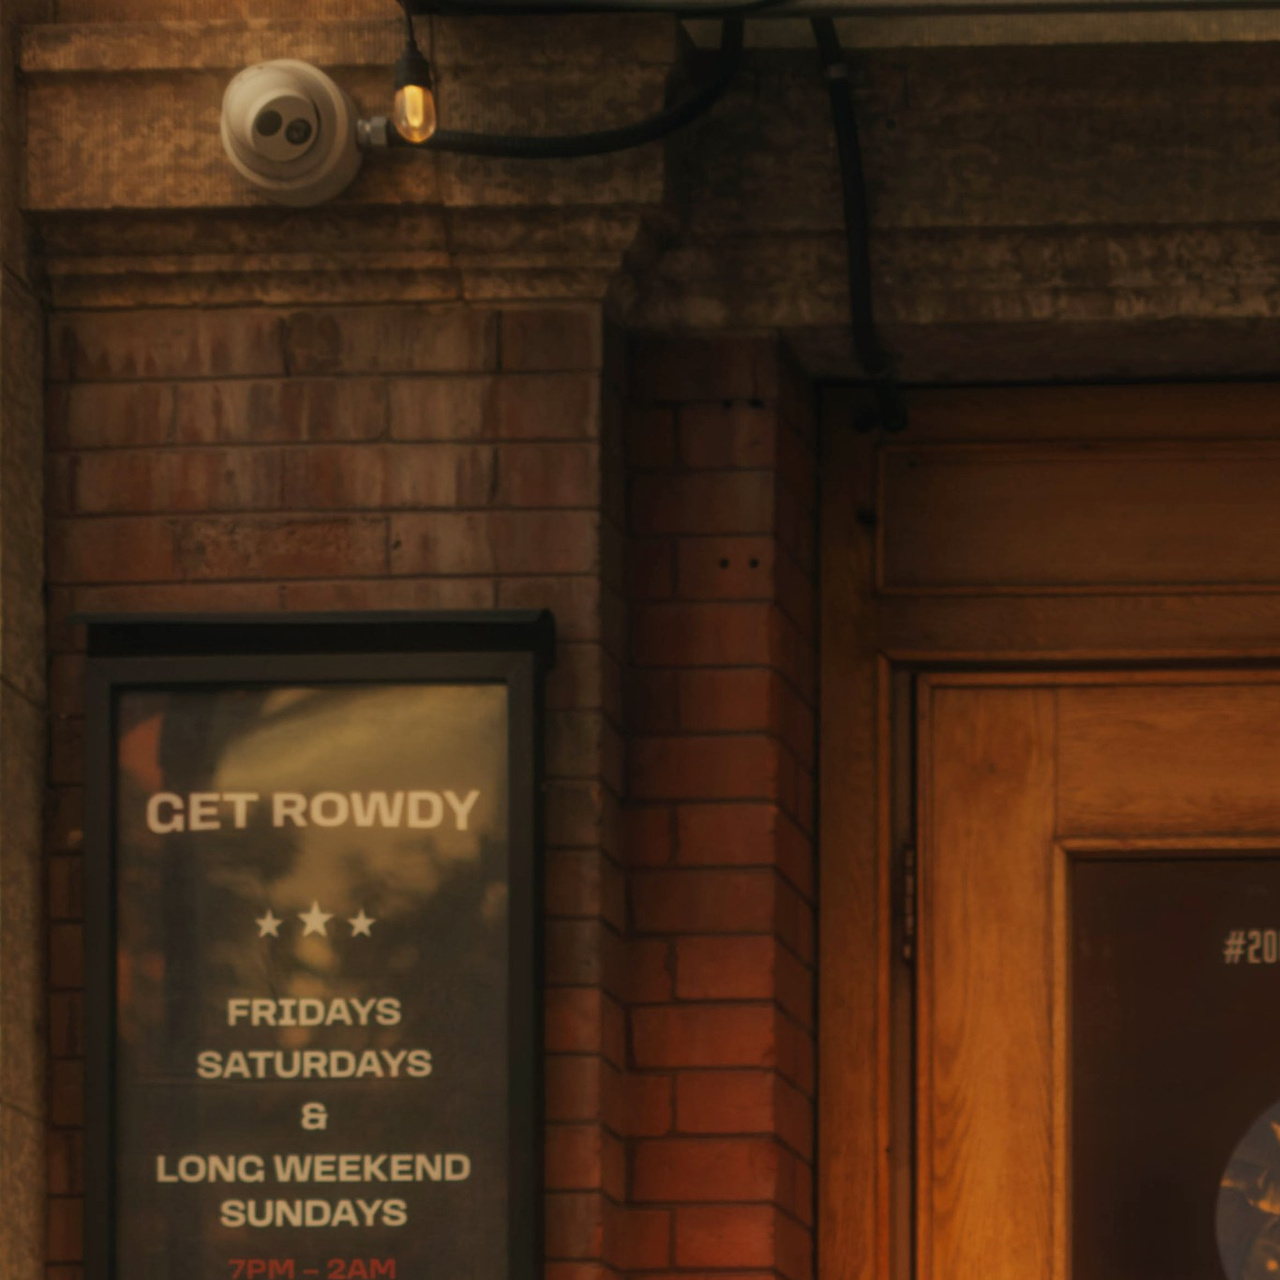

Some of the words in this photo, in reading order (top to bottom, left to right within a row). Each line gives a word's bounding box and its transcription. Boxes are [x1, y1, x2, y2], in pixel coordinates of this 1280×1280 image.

[146, 791, 260, 833] GET
[272, 789, 481, 831] ROWDY
[226, 997, 403, 1027] FRIDAYS
[196, 1049, 433, 1079] SATURDAYS
[300, 1102, 328, 1131] &
[155, 1154, 266, 1183] LONG
[273, 1153, 472, 1183] WEEKEND
[220, 1199, 409, 1228] SUNDAYS
[227, 1258, 297, 1280] 7PM
[326, 1257, 398, 1280] 2AM
